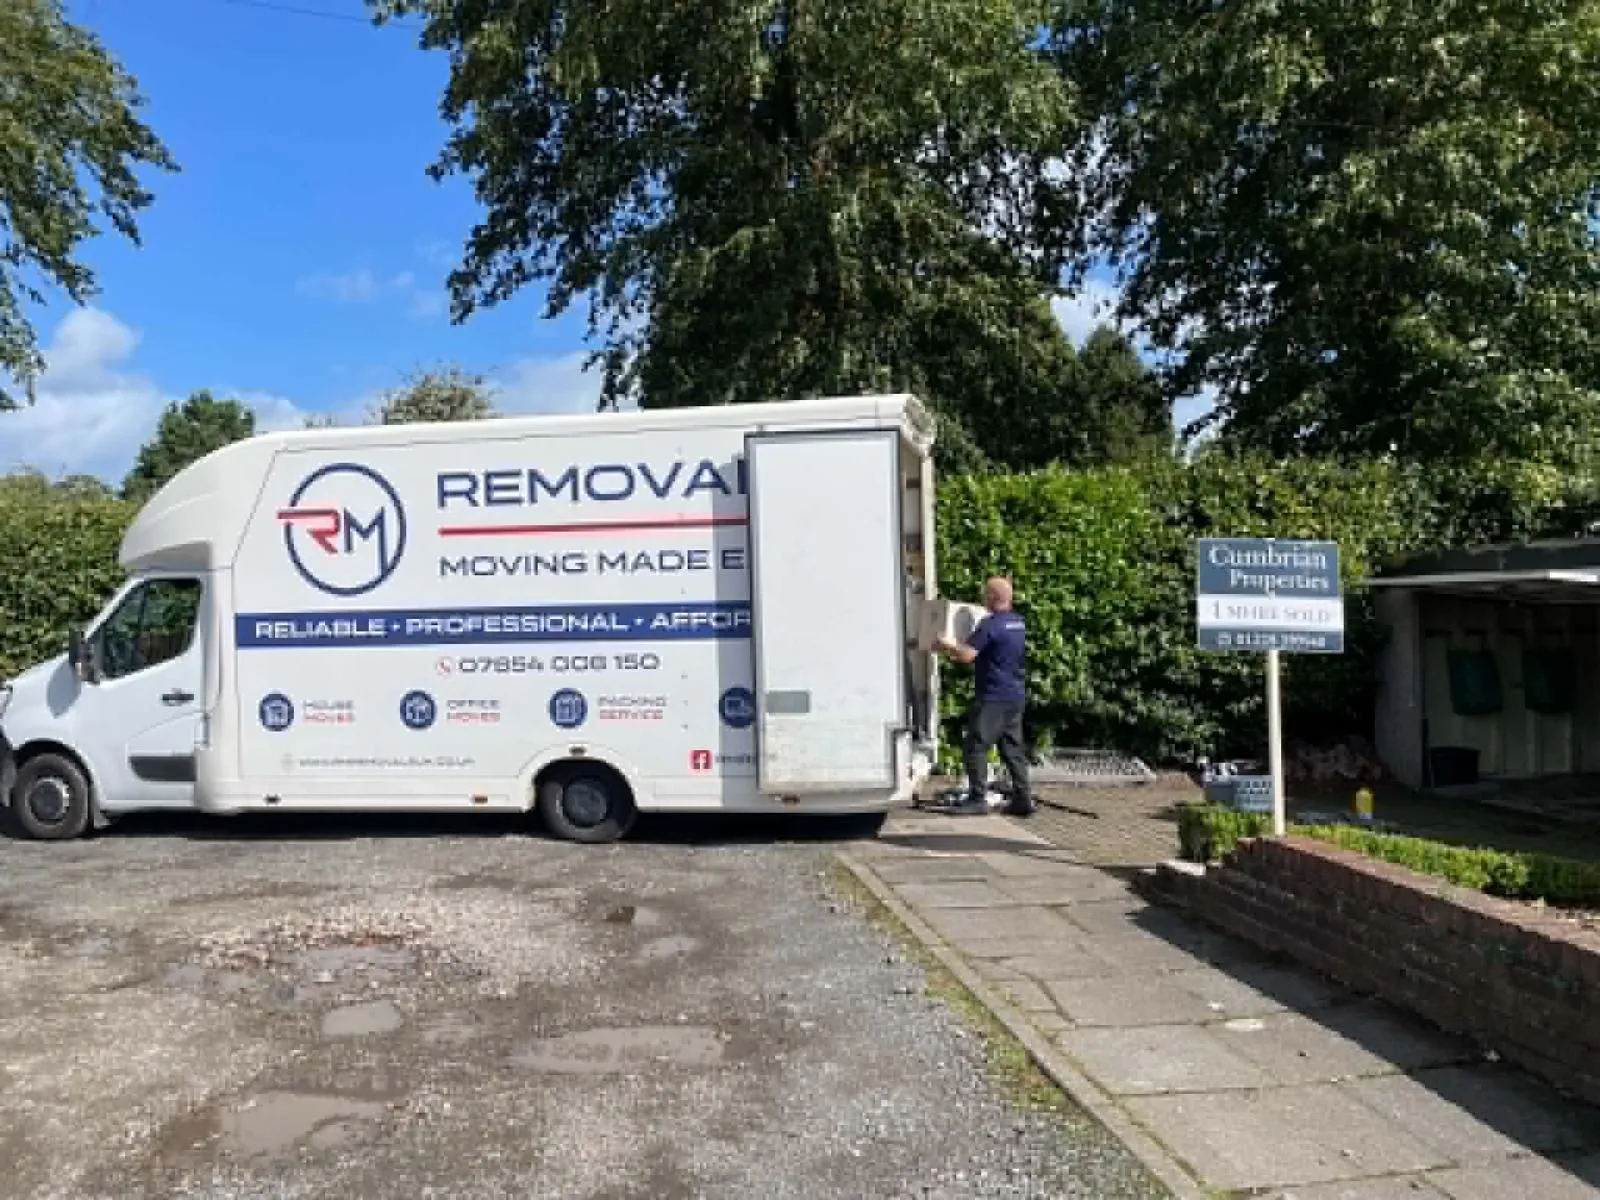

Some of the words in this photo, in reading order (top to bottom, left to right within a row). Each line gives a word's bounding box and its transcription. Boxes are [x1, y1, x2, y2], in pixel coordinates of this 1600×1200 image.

[439, 552, 589, 578] MOVING
[599, 549, 709, 575] MADE
[1207, 543, 1328, 570] Cumbrian
[1230, 567, 1330, 594] Properties
[255, 618, 388, 640] RELIABLE
[405, 611, 631, 637] PROFESSIONAL
[613, 652, 661, 671] 150
[447, 699, 501, 711] OFFICE
[598, 695, 667, 707] PACKING
[447, 712, 501, 723] MOVES
[599, 708, 665, 720] SERVICE
